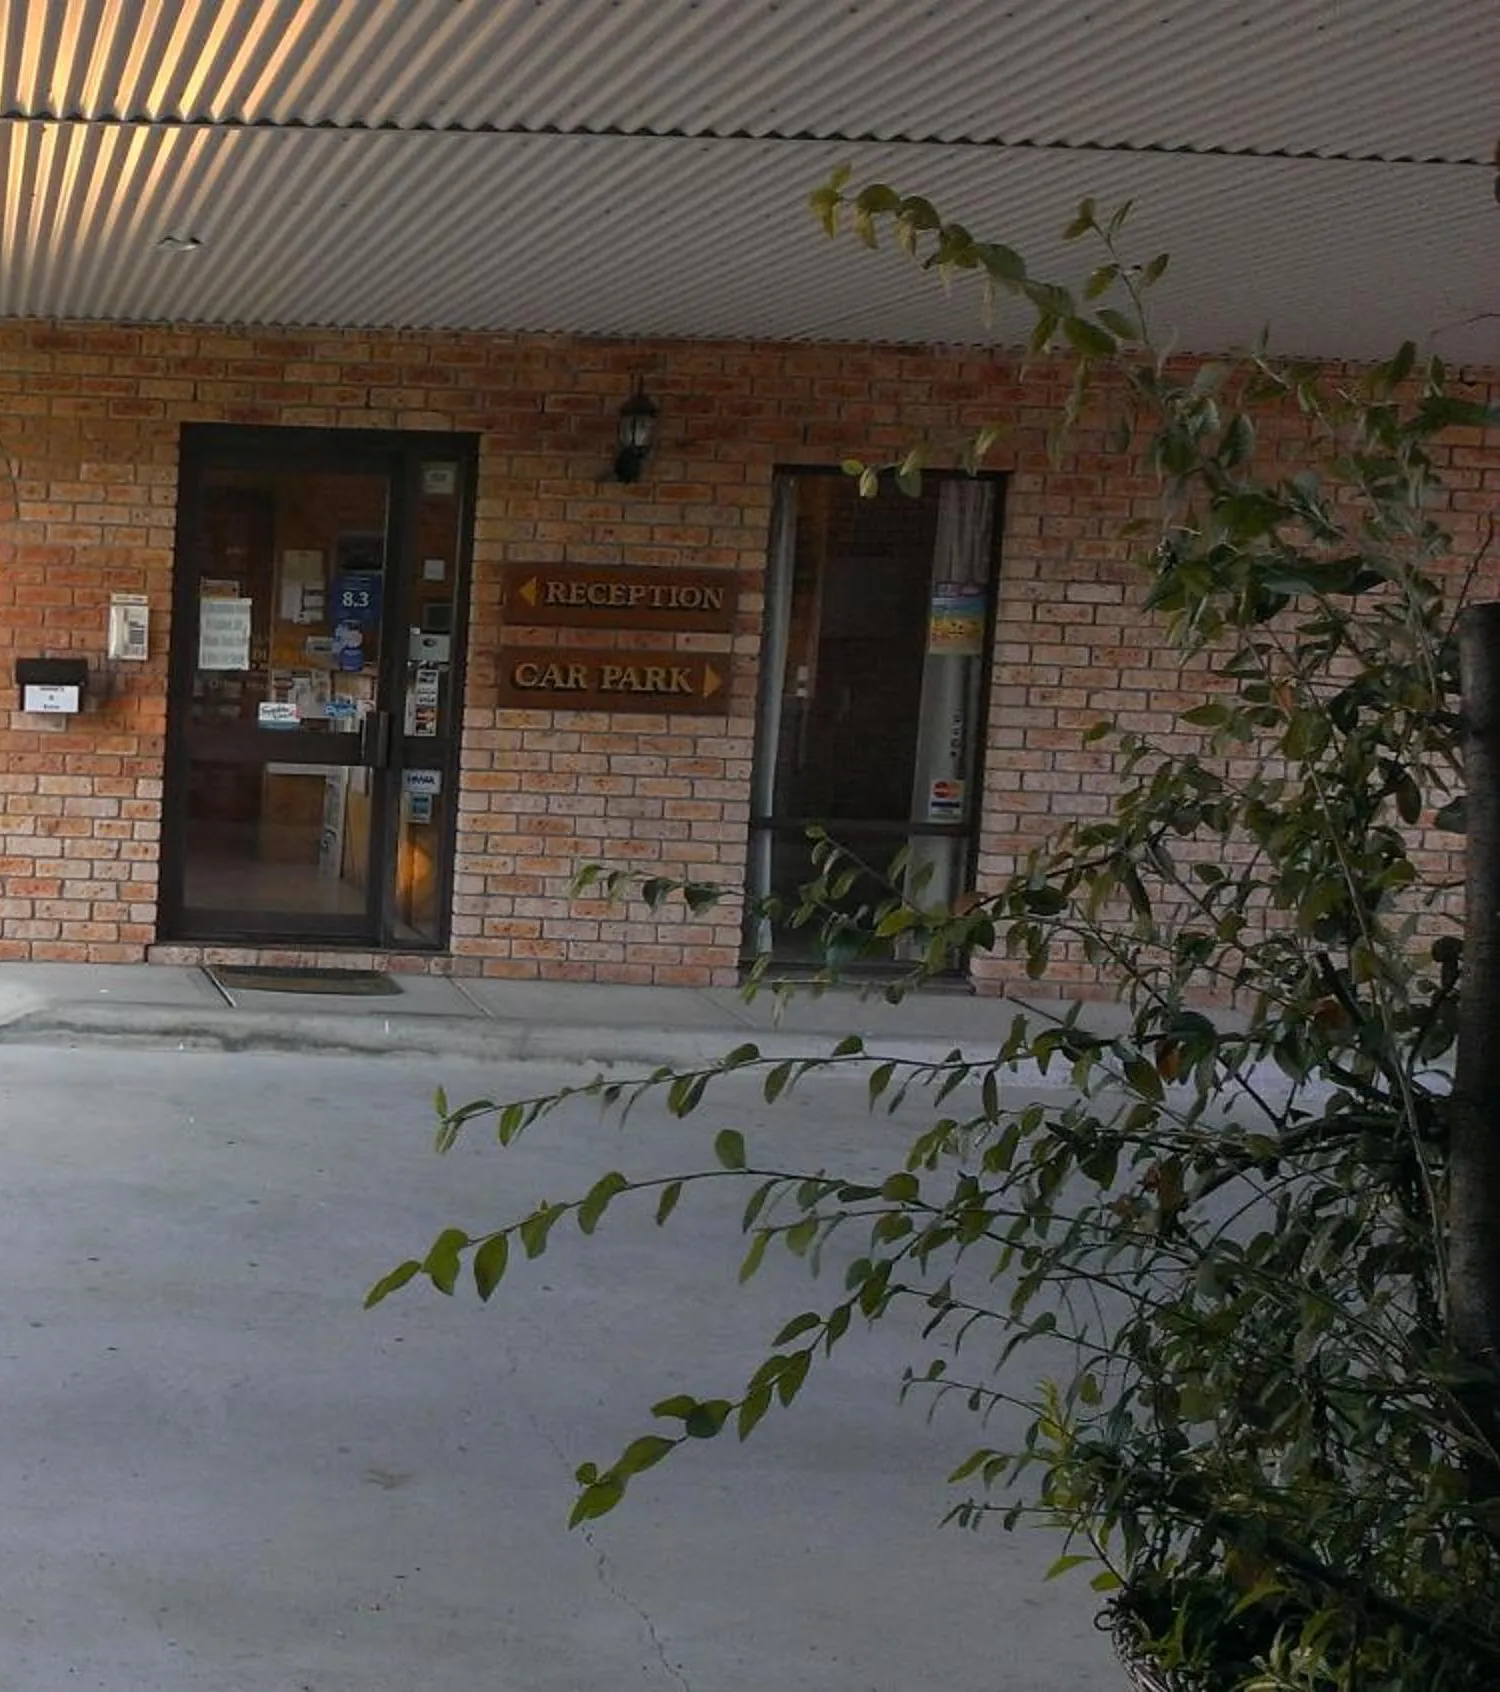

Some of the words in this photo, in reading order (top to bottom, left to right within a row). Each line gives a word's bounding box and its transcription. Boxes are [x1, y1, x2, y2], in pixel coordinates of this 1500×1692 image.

[342, 591, 369, 607] 8.3
[547, 580, 724, 609] RECEPTION
[515, 663, 587, 689] CAR
[600, 665, 694, 694] PARK
